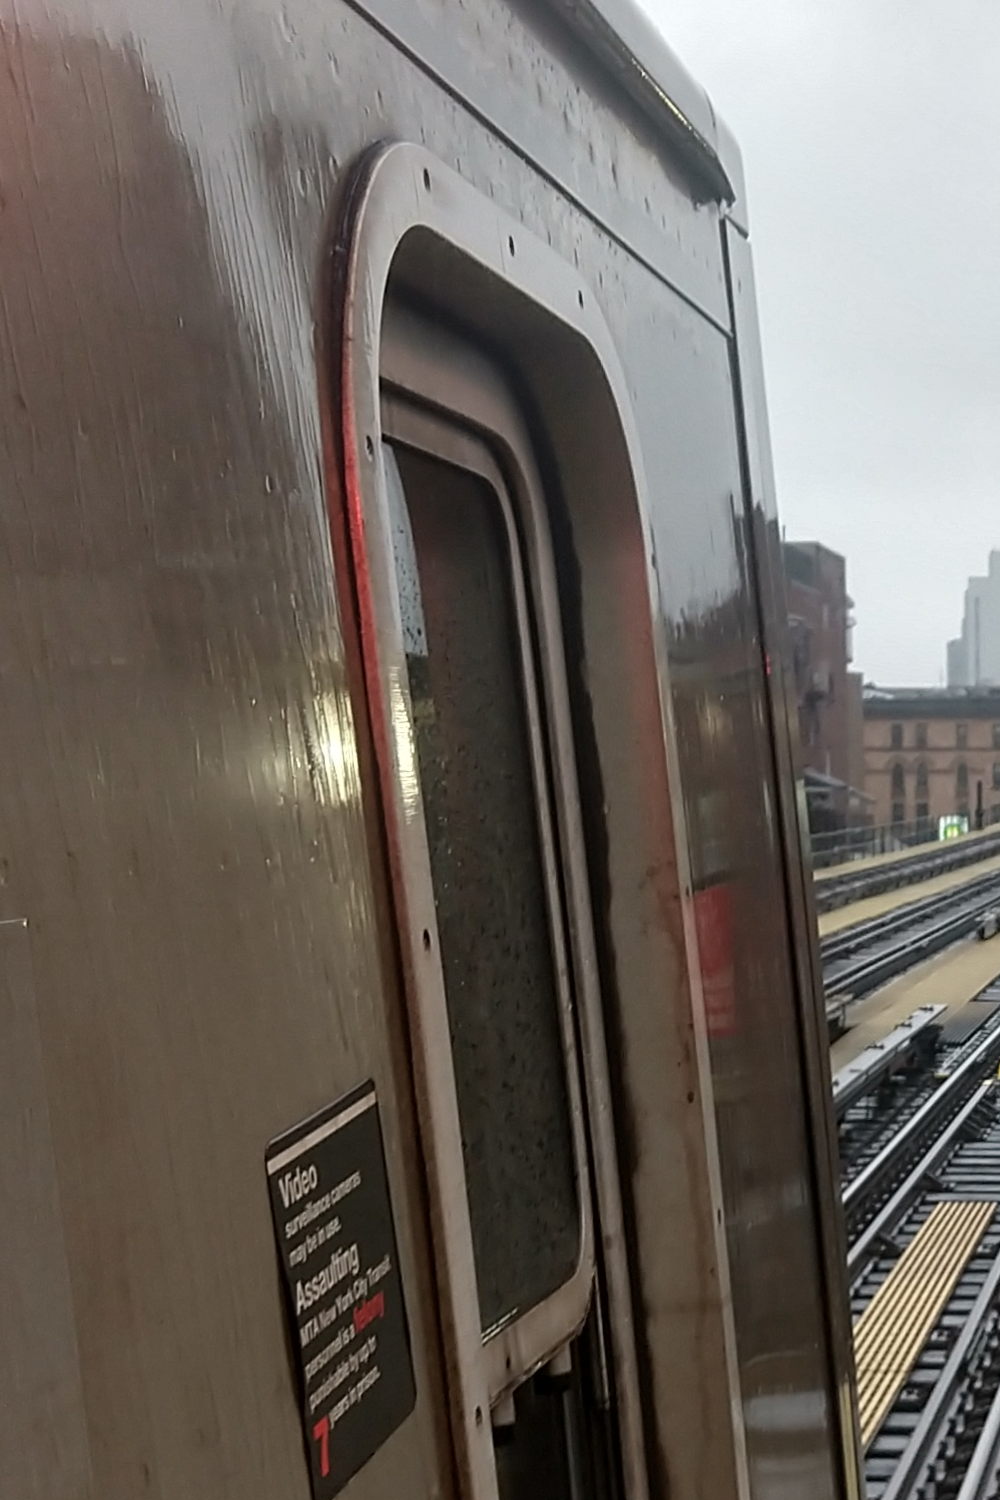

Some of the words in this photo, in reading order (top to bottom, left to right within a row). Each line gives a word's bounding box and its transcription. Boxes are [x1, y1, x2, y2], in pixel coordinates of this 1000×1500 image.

[278, 1164, 318, 1208] Video
[285, 1192, 331, 1239] surveillance
[330, 1170, 361, 1205] cameras
[289, 1242, 307, 1267] may
[305, 1234, 318, 1254] be
[316, 1226, 326, 1245] in
[325, 1215, 342, 1239] use.
[296, 1243, 359, 1316] Assaulting
[299, 1316, 319, 1348] MTA
[318, 1305, 337, 1332] New
[335, 1288, 355, 1315] York
[353, 1275, 368, 1299] City
[366, 1254, 392, 1287] Transit
[304, 1330, 343, 1383] personnel
[313, 1415, 330, 1477] 7
[329, 1394, 350, 1430] years
